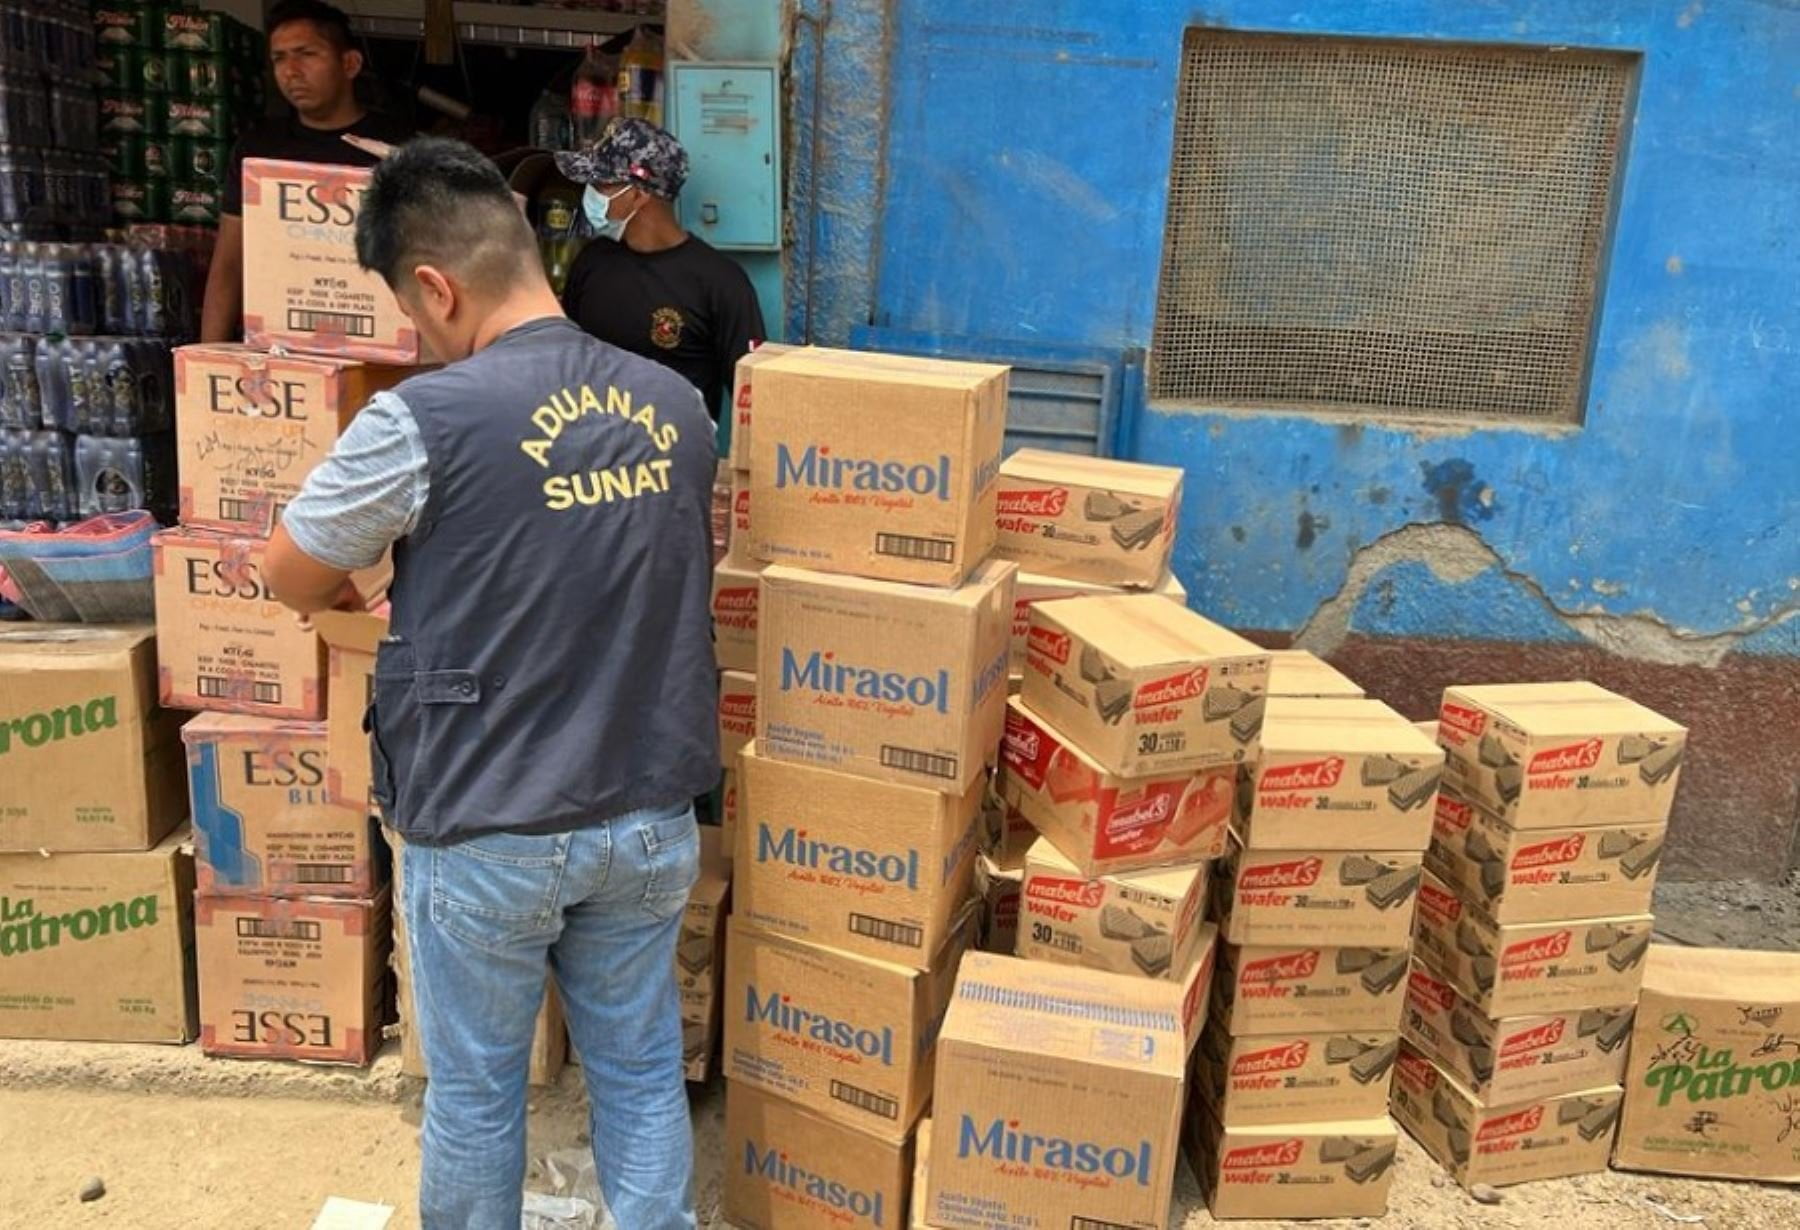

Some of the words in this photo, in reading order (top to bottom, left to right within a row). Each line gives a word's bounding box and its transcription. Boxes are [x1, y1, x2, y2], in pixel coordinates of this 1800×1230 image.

[208, 374, 308, 421] ESSE
[520, 384, 679, 470] ADUANAS
[776, 442, 950, 501] Mirasol
[543, 459, 673, 511] SUNAT
[780, 646, 949, 715] Mirasol
[1135, 707, 1183, 725] wafer
[243, 750, 328, 787] ESS
[1528, 774, 1576, 791] wafer
[1260, 793, 1313, 809] wafer
[757, 821, 919, 892] Mirasol
[1511, 868, 1557, 885] wafer
[1030, 879, 1101, 907] mabel's
[1240, 890, 1291, 906] wafer
[2, 897, 33, 922] La
[1027, 900, 1078, 923] wafer
[1032, 921, 1052, 943] 30
[1501, 965, 1545, 981] wafer
[1240, 984, 1291, 999] wafer
[232, 1009, 333, 1048] ESSE
[745, 983, 893, 1067] Mirasol
[1697, 1045, 1732, 1069] La
[1232, 1076, 1281, 1091] wafer
[958, 1114, 1152, 1187] Mirasol
[745, 1138, 884, 1229] Mirasol
[1224, 1171, 1274, 1185] wafer
